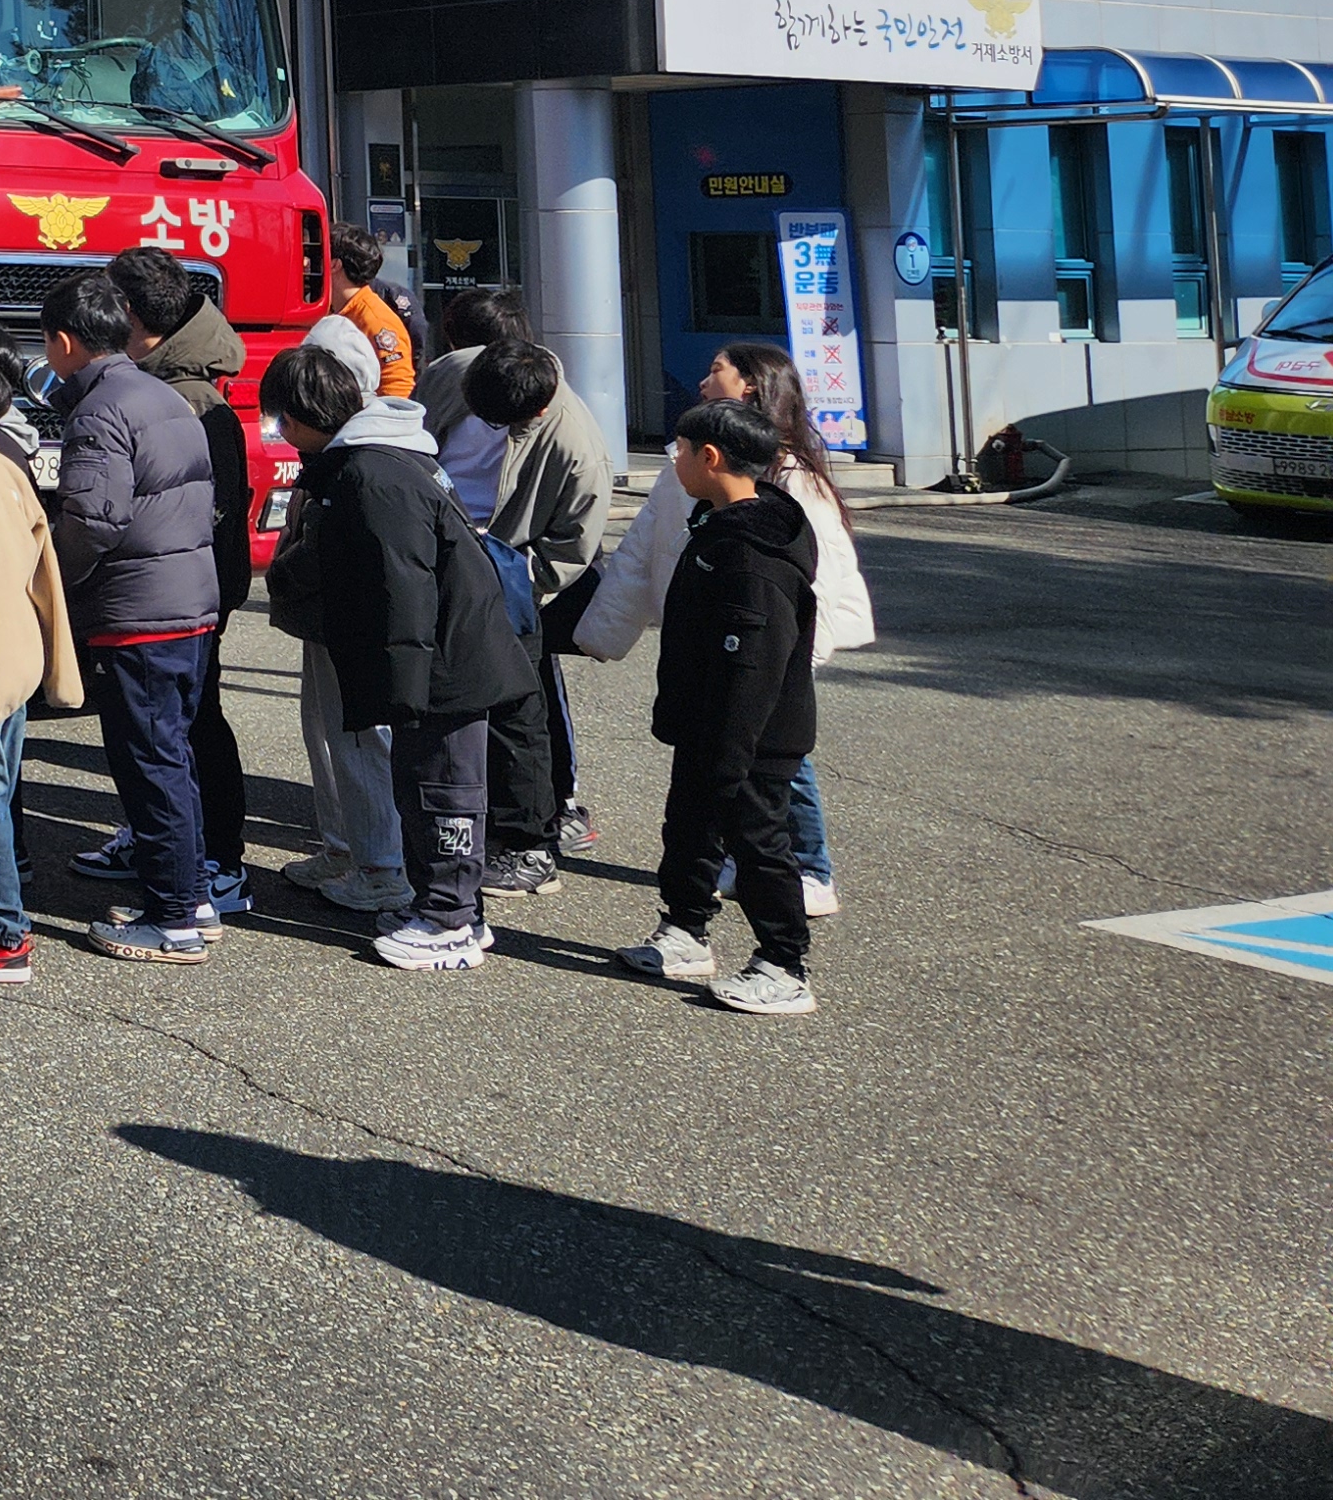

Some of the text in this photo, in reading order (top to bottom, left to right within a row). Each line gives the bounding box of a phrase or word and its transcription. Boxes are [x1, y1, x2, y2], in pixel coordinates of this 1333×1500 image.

[875, 8, 966, 52] 국민안전
[971, 42, 1033, 66] 거제소방서
[708, 174, 785, 195] 민원안내실
[139, 194, 235, 257] 소방
[909, 253, 915, 268] 1
[795, 270, 838, 295] 운동
[273, 461, 304, 484] 거제
[438, 826, 473, 856] 24
[105, 942, 153, 960] crocs
